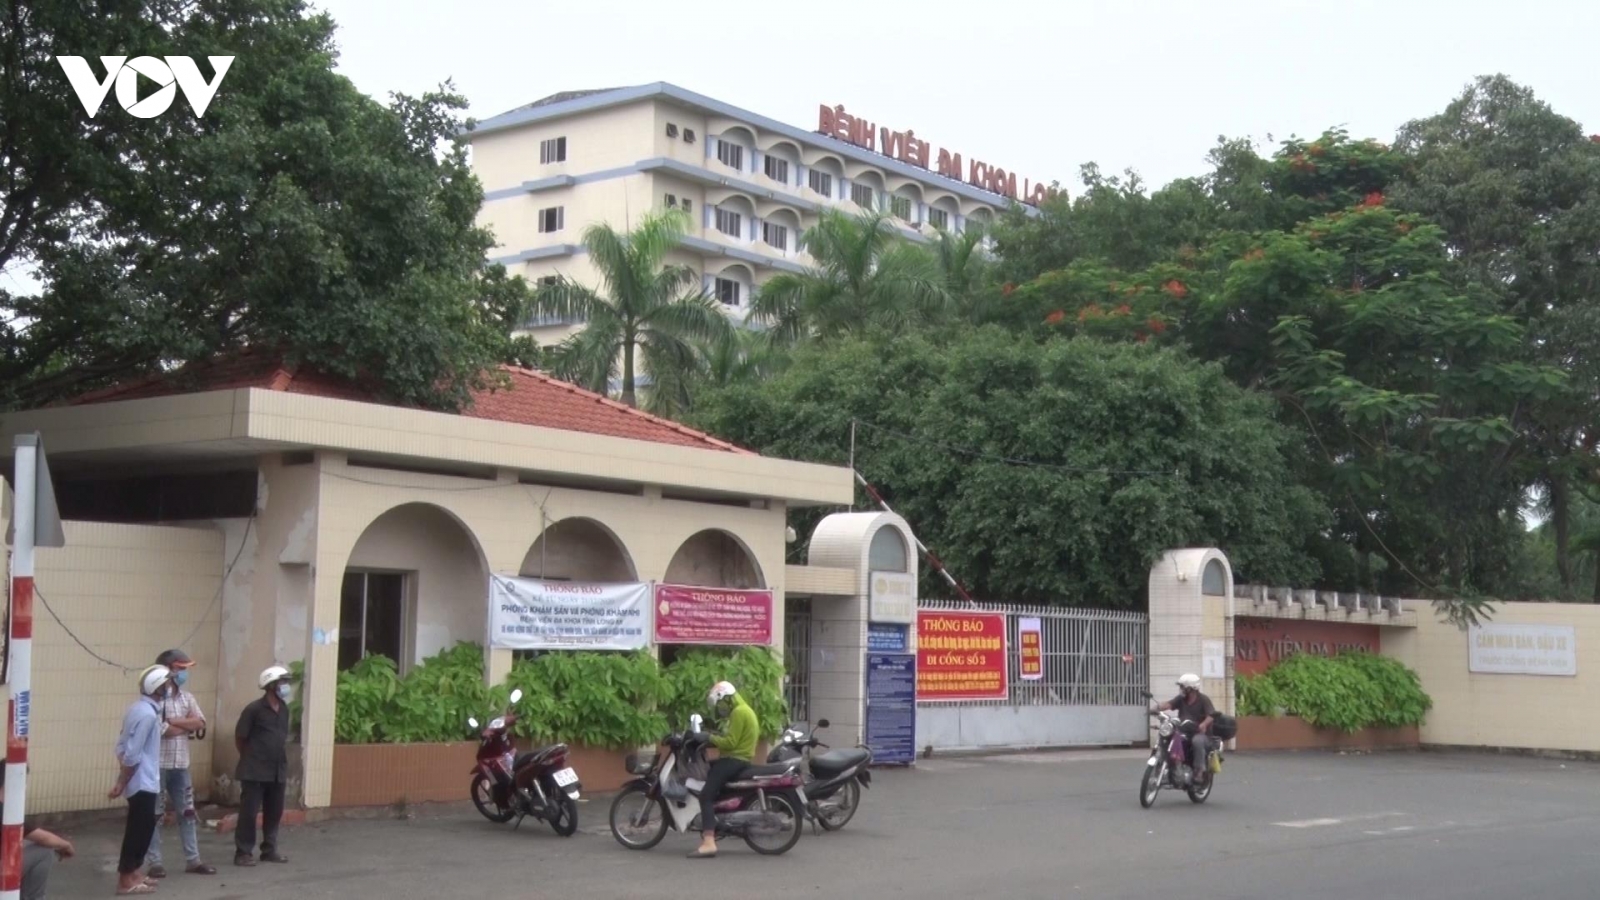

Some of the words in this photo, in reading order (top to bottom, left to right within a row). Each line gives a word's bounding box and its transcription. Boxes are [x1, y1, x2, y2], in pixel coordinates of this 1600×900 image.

[969, 157, 1018, 200] KHOA
[923, 616, 960, 631] THÔNG
[962, 617, 984, 632] BÁO
[966, 651, 979, 666] SỐ
[979, 654, 986, 666] 3
